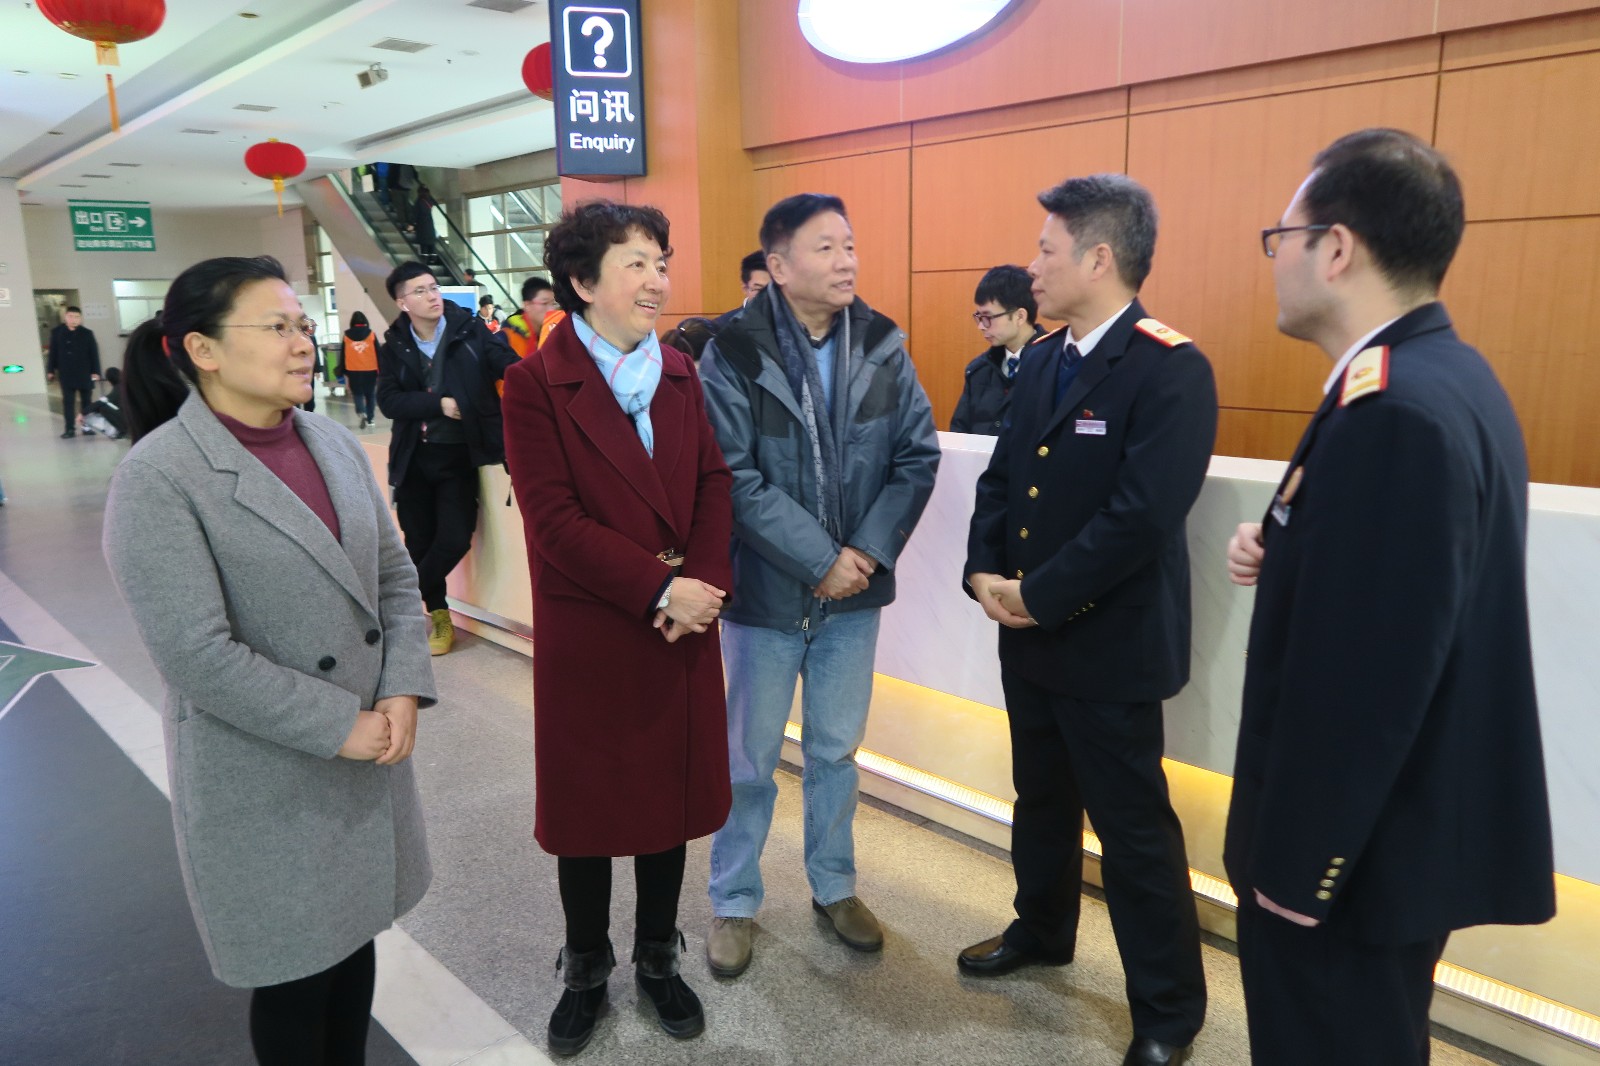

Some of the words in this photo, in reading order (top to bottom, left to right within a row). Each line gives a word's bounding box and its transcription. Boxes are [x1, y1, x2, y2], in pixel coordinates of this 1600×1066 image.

[569, 89, 635, 122] 问讯
[569, 133, 635, 153] Enquiry
[75, 211, 103, 225] 出口
